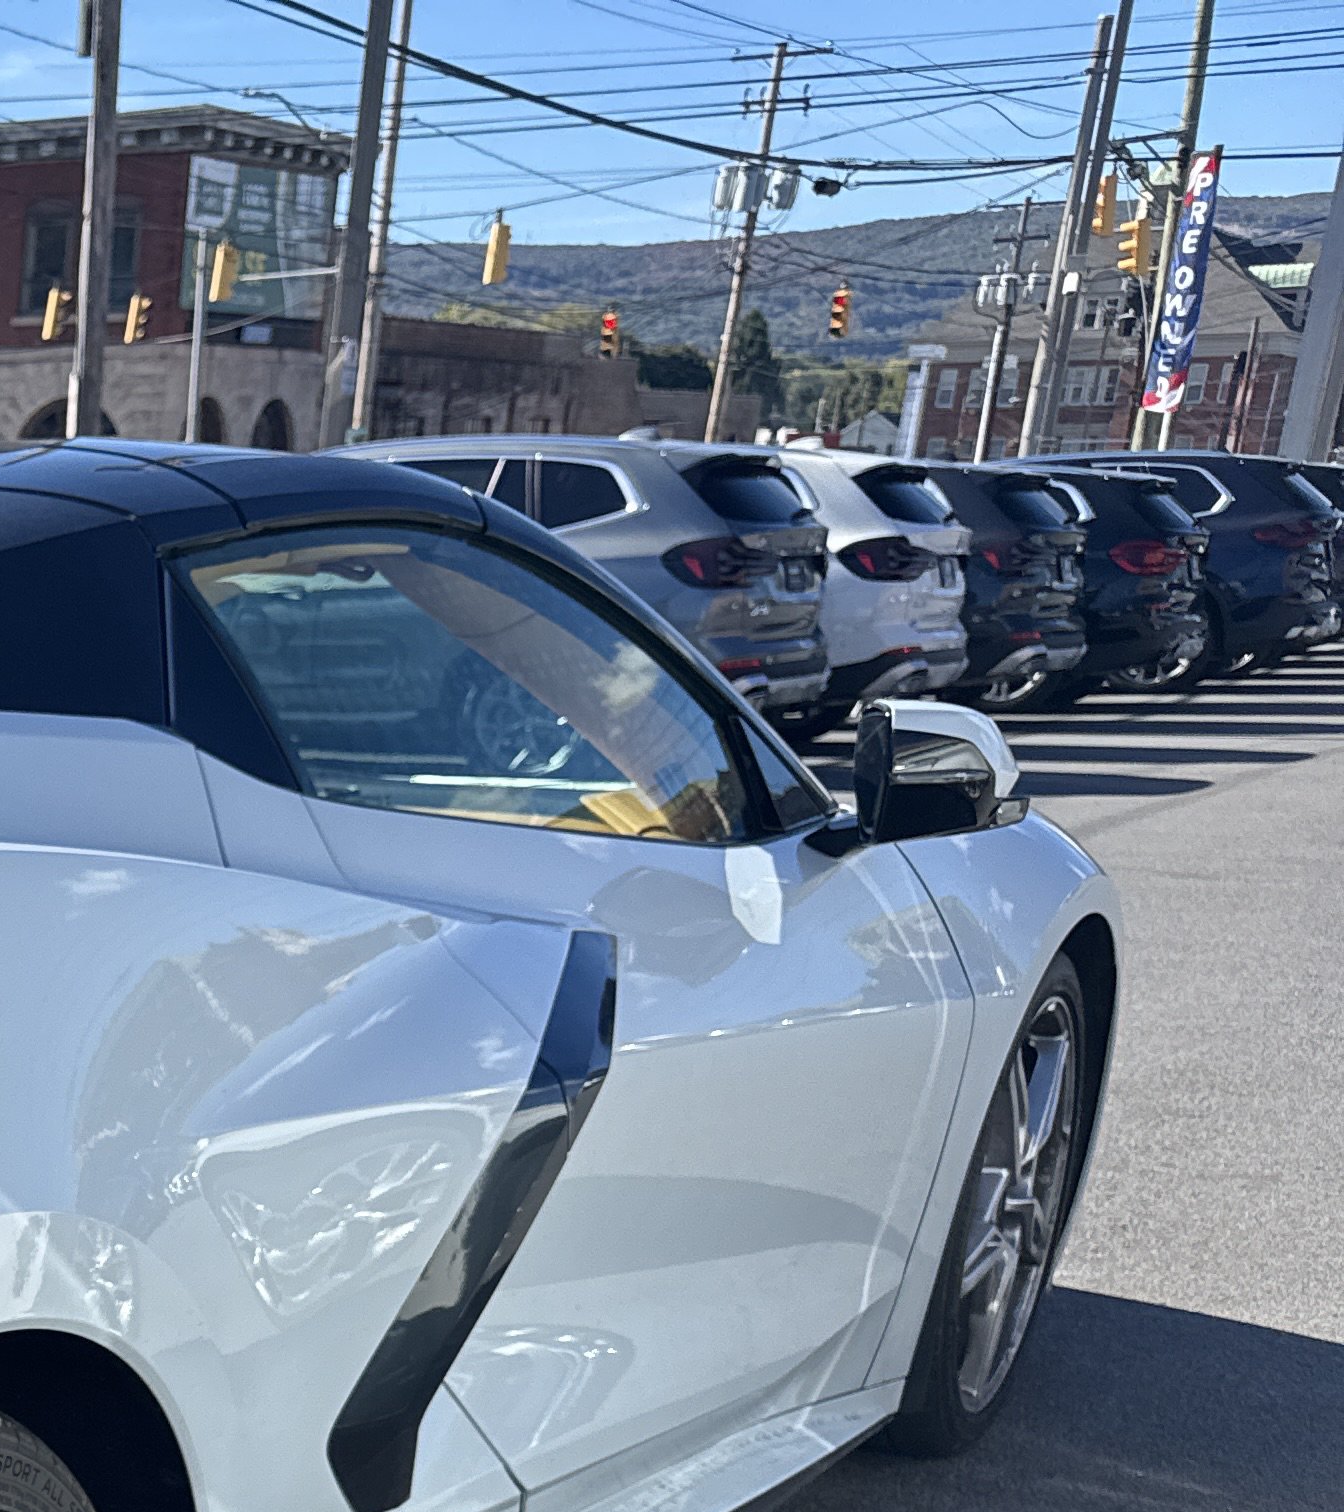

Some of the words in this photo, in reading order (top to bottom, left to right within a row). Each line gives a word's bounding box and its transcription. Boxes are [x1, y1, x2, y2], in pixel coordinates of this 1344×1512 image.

[1181, 172, 1214, 254] PRE
[1155, 264, 1198, 398] OWNED
[40, 1476, 66, 1509] ALL
